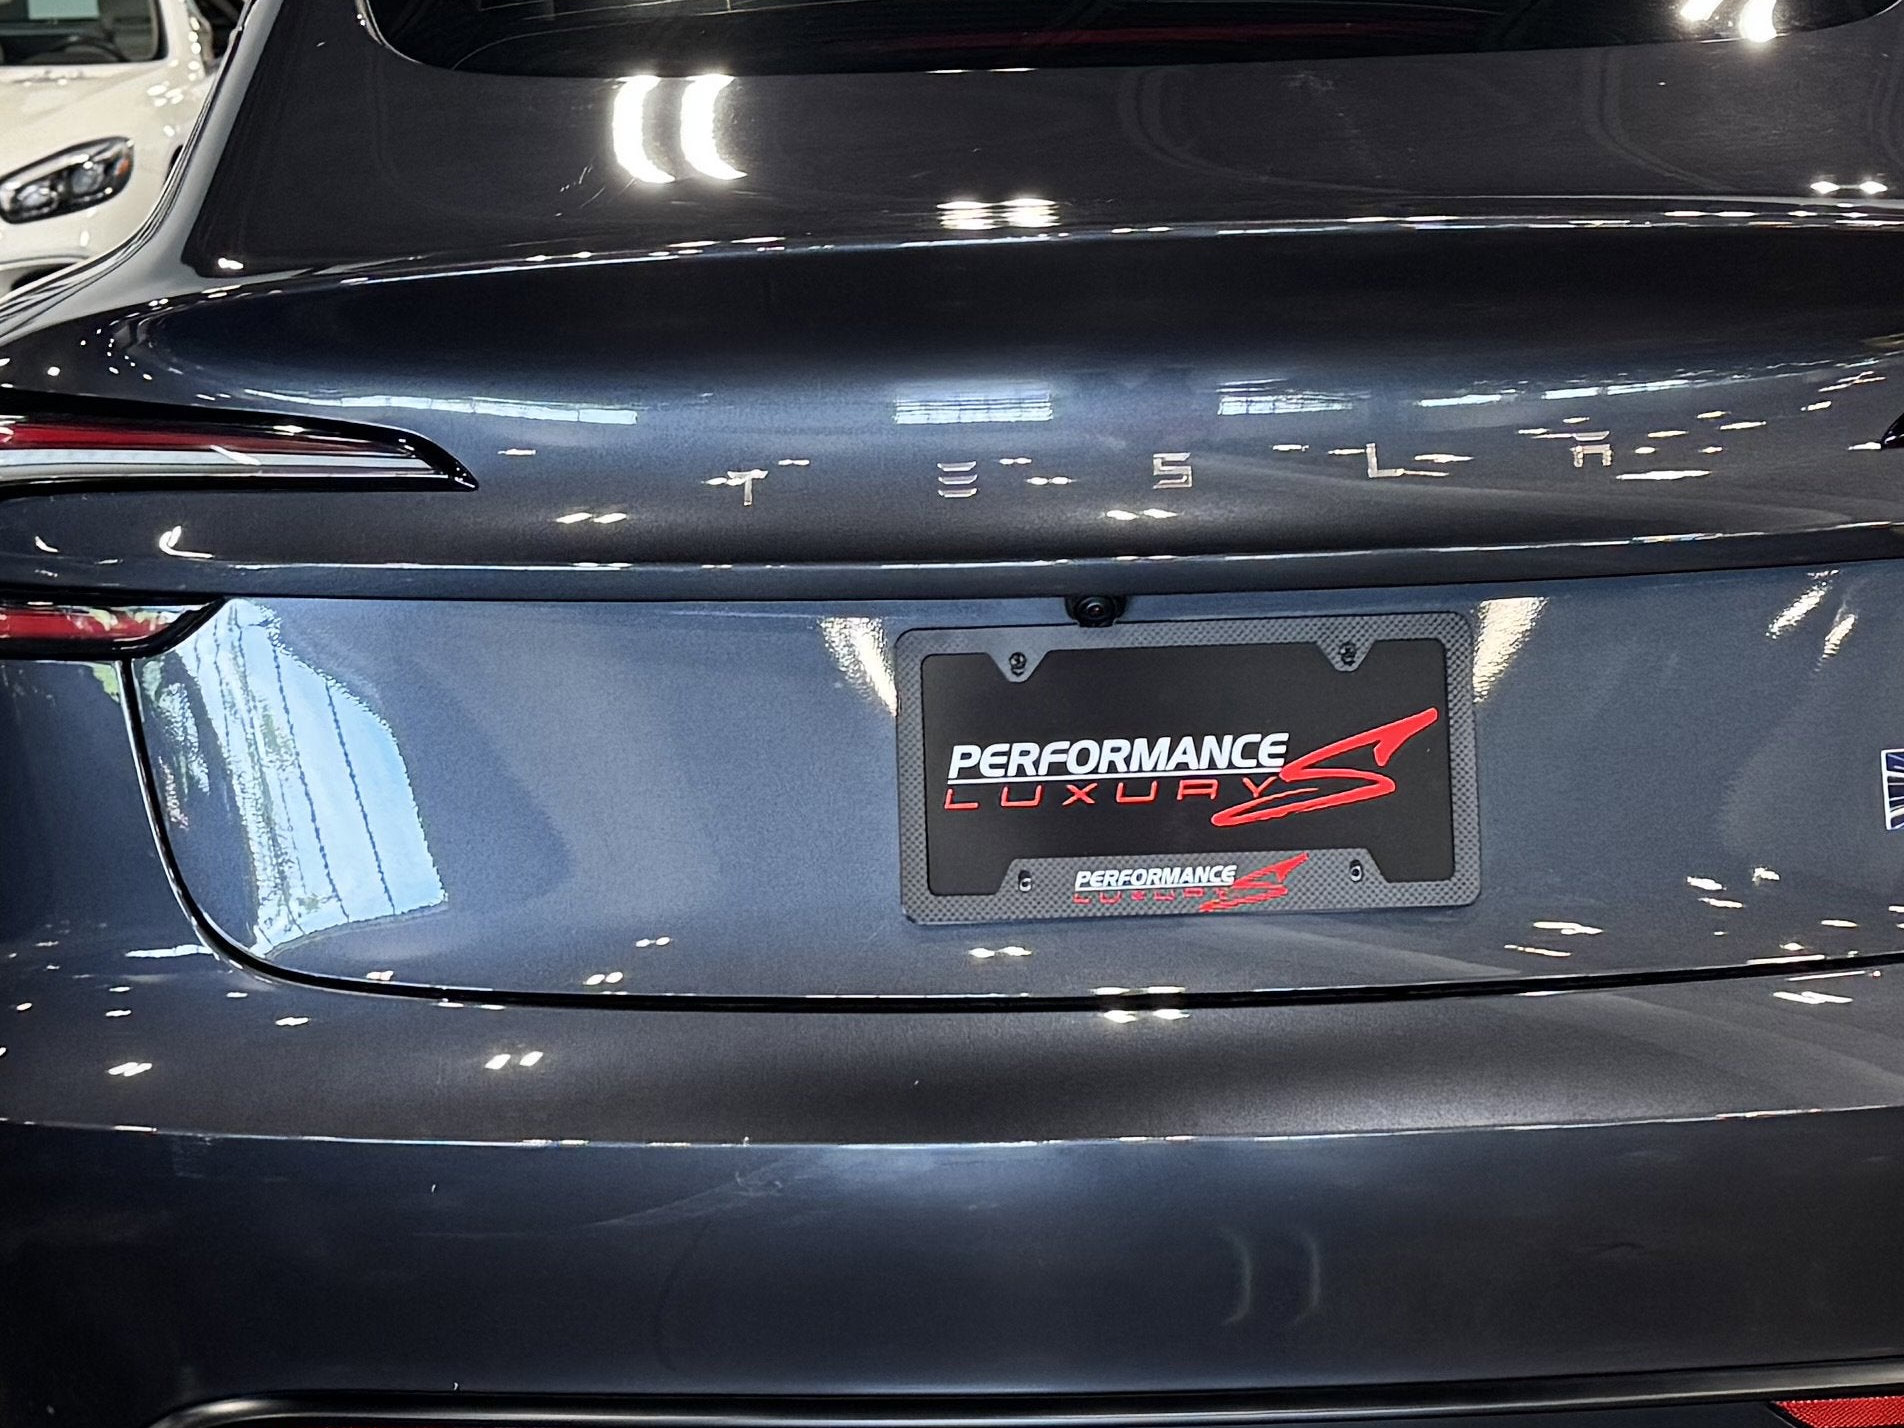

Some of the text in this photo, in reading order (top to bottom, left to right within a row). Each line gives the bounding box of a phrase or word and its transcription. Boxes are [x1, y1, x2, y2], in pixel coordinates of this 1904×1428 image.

[727, 431, 1612, 507] TESLA
[948, 732, 1290, 780] PERFORMANCE
[943, 776, 1279, 810] LUXURY
[1075, 864, 1238, 889] PERFORMANCE
